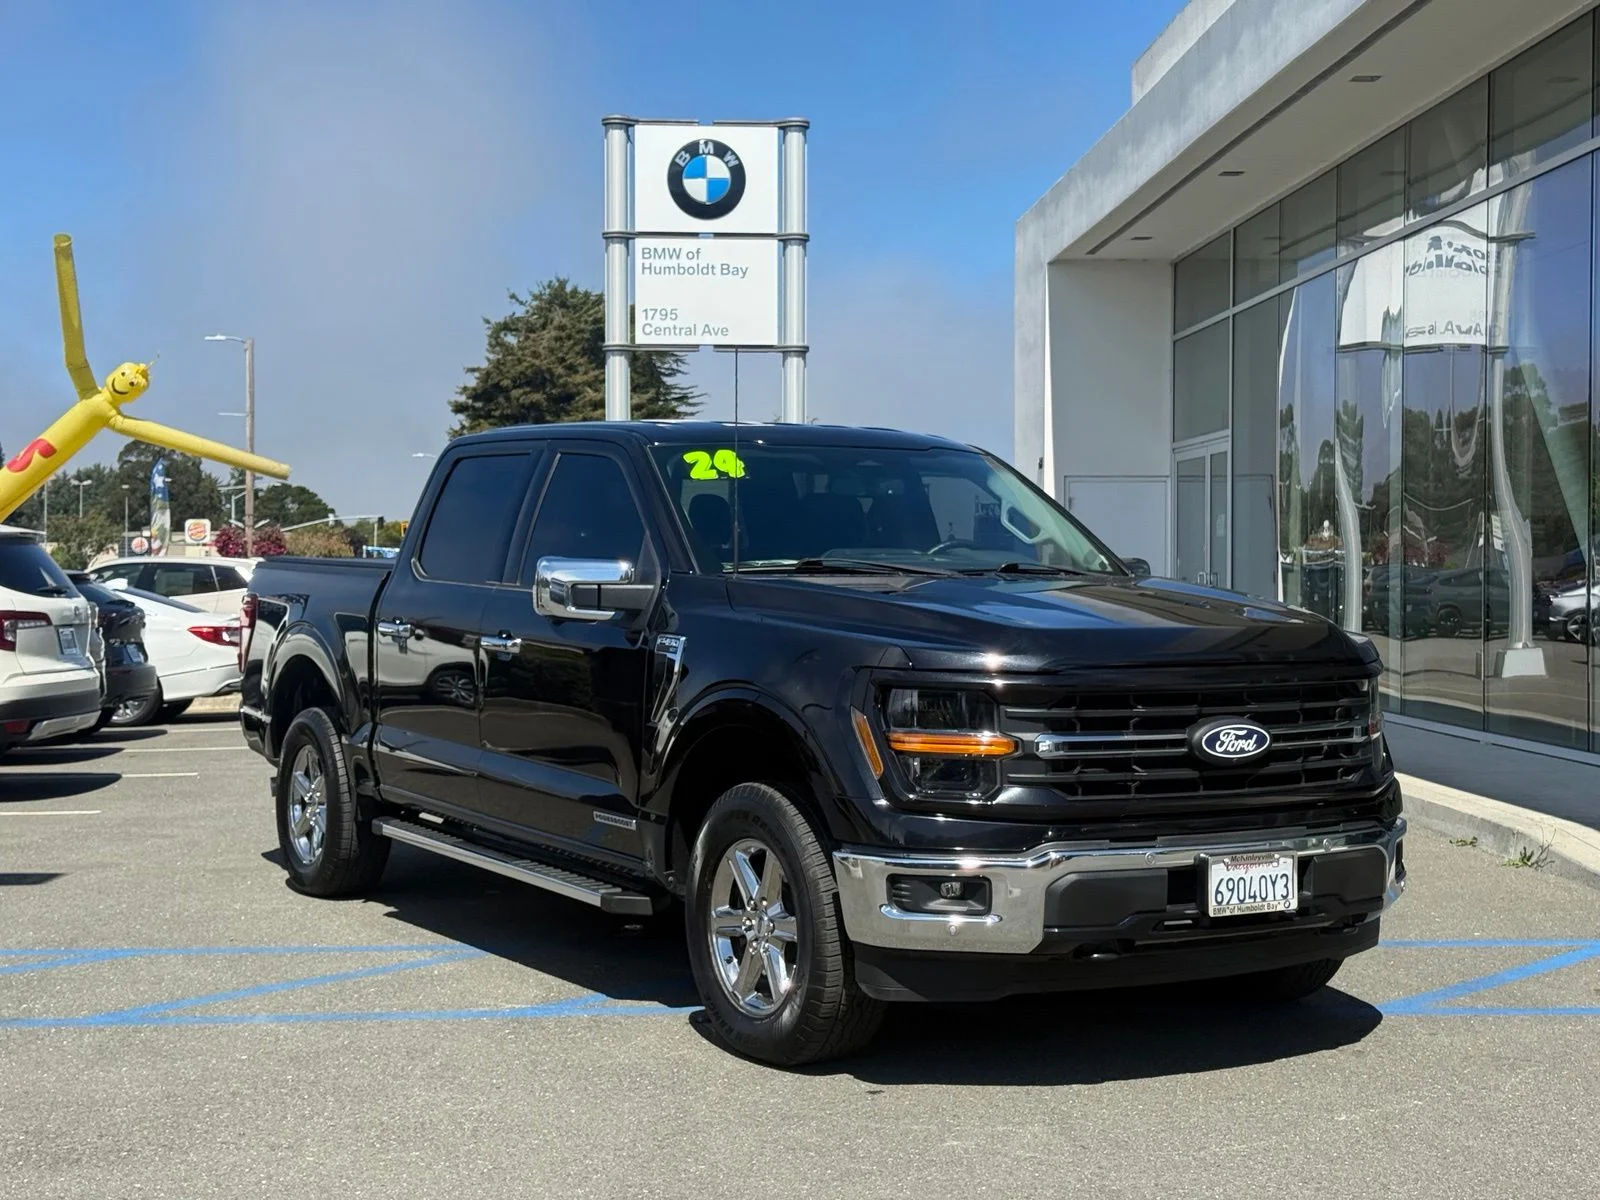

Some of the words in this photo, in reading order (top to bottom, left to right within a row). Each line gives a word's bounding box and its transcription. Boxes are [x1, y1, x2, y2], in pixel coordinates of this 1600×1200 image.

[675, 141, 738, 167] BMW
[641, 248, 681, 260] BMW
[686, 247, 701, 260] of
[641, 263, 716, 276] Humboldt
[720, 264, 749, 279] Bay
[642, 308, 678, 321] 1795
[642, 323, 697, 337] Central
[701, 324, 729, 337] Ave
[1215, 729, 1257, 752] Ford
[1214, 873, 1289, 906] 69040Y3
[1237, 903, 1265, 913] Humboldt
